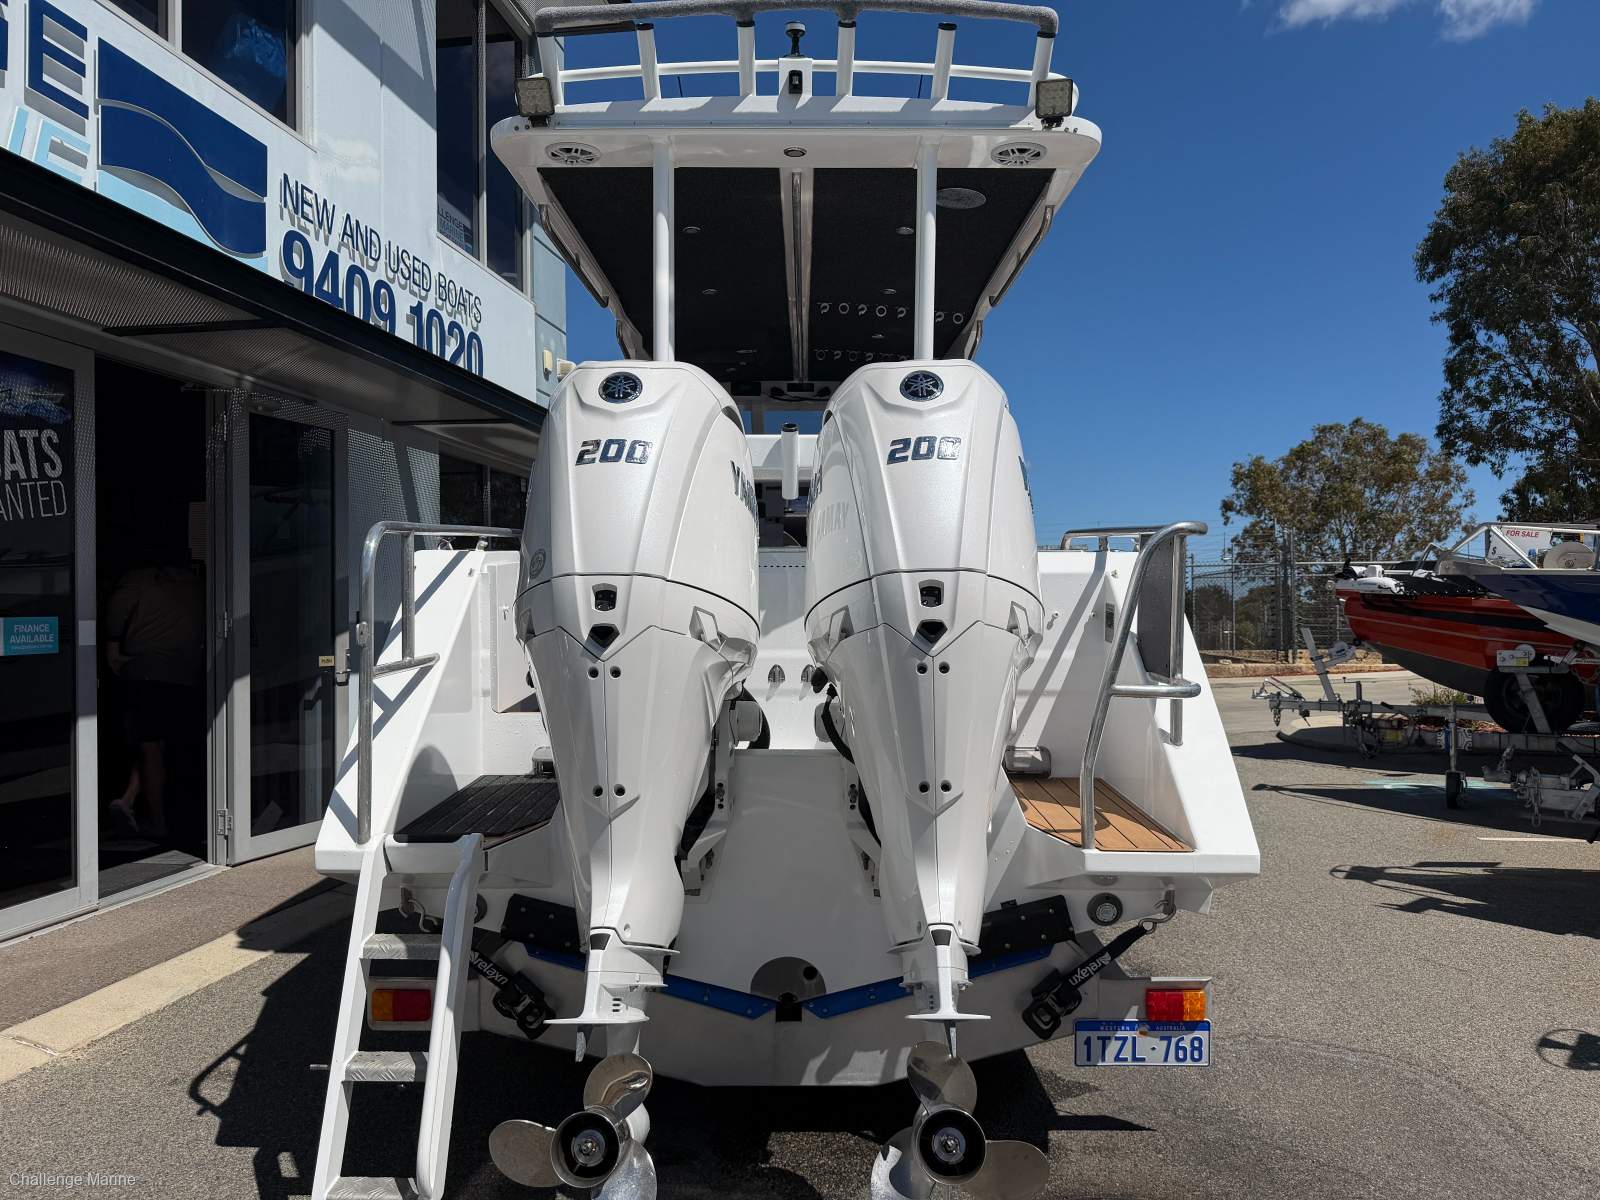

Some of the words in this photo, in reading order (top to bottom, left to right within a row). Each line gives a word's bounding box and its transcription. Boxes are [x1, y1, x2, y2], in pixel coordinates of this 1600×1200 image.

[283, 172, 336, 235] NEW
[341, 213, 382, 262] AND
[388, 240, 432, 292] USED
[438, 272, 482, 323] BOATS
[283, 229, 397, 336] 9409
[409, 300, 484, 378] 1020
[0, 428, 63, 481] ATS
[575, 438, 650, 466] 200
[886, 436, 962, 465] 200
[1505, 529, 1520, 537] FOR
[1521, 530, 1539, 538] SALE
[10, 633, 55, 644] AVAILABLE
[14, 623, 49, 633] FINANCE
[473, 958, 508, 985] relaxn
[1069, 959, 1102, 986] relaxn
[1084, 1035, 1146, 1063] 1TZL
[1160, 1035, 1203, 1063] 768
